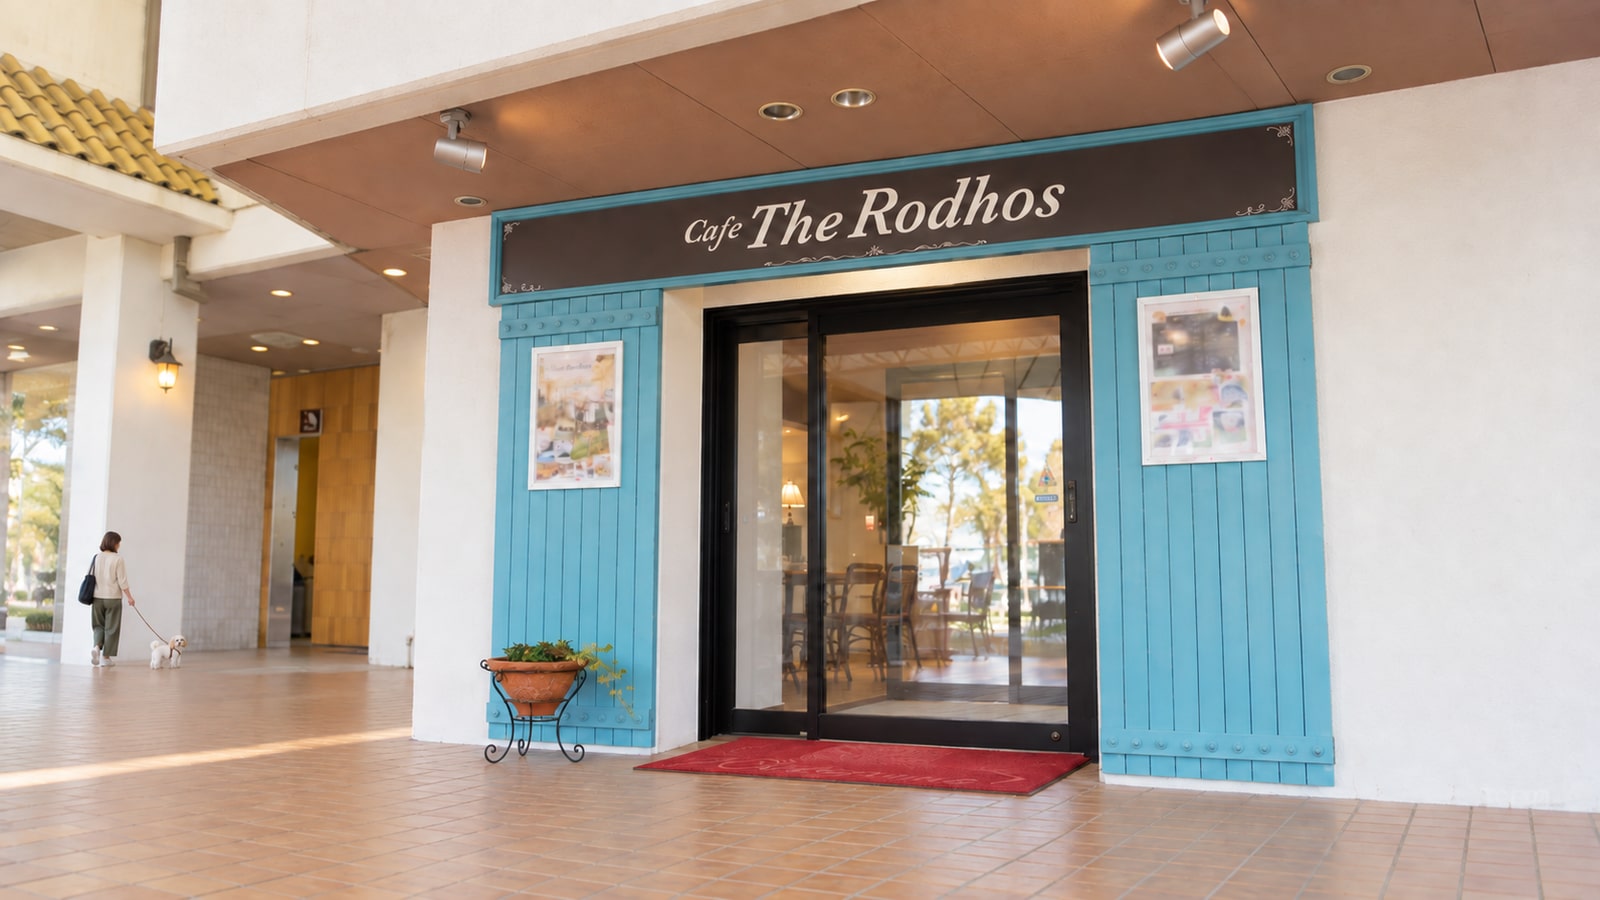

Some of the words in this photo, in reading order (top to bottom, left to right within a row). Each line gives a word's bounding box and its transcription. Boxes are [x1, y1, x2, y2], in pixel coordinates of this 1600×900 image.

[684, 215, 743, 252] Cafe
[746, 199, 844, 249] The
[847, 174, 1067, 239] Rodhos
